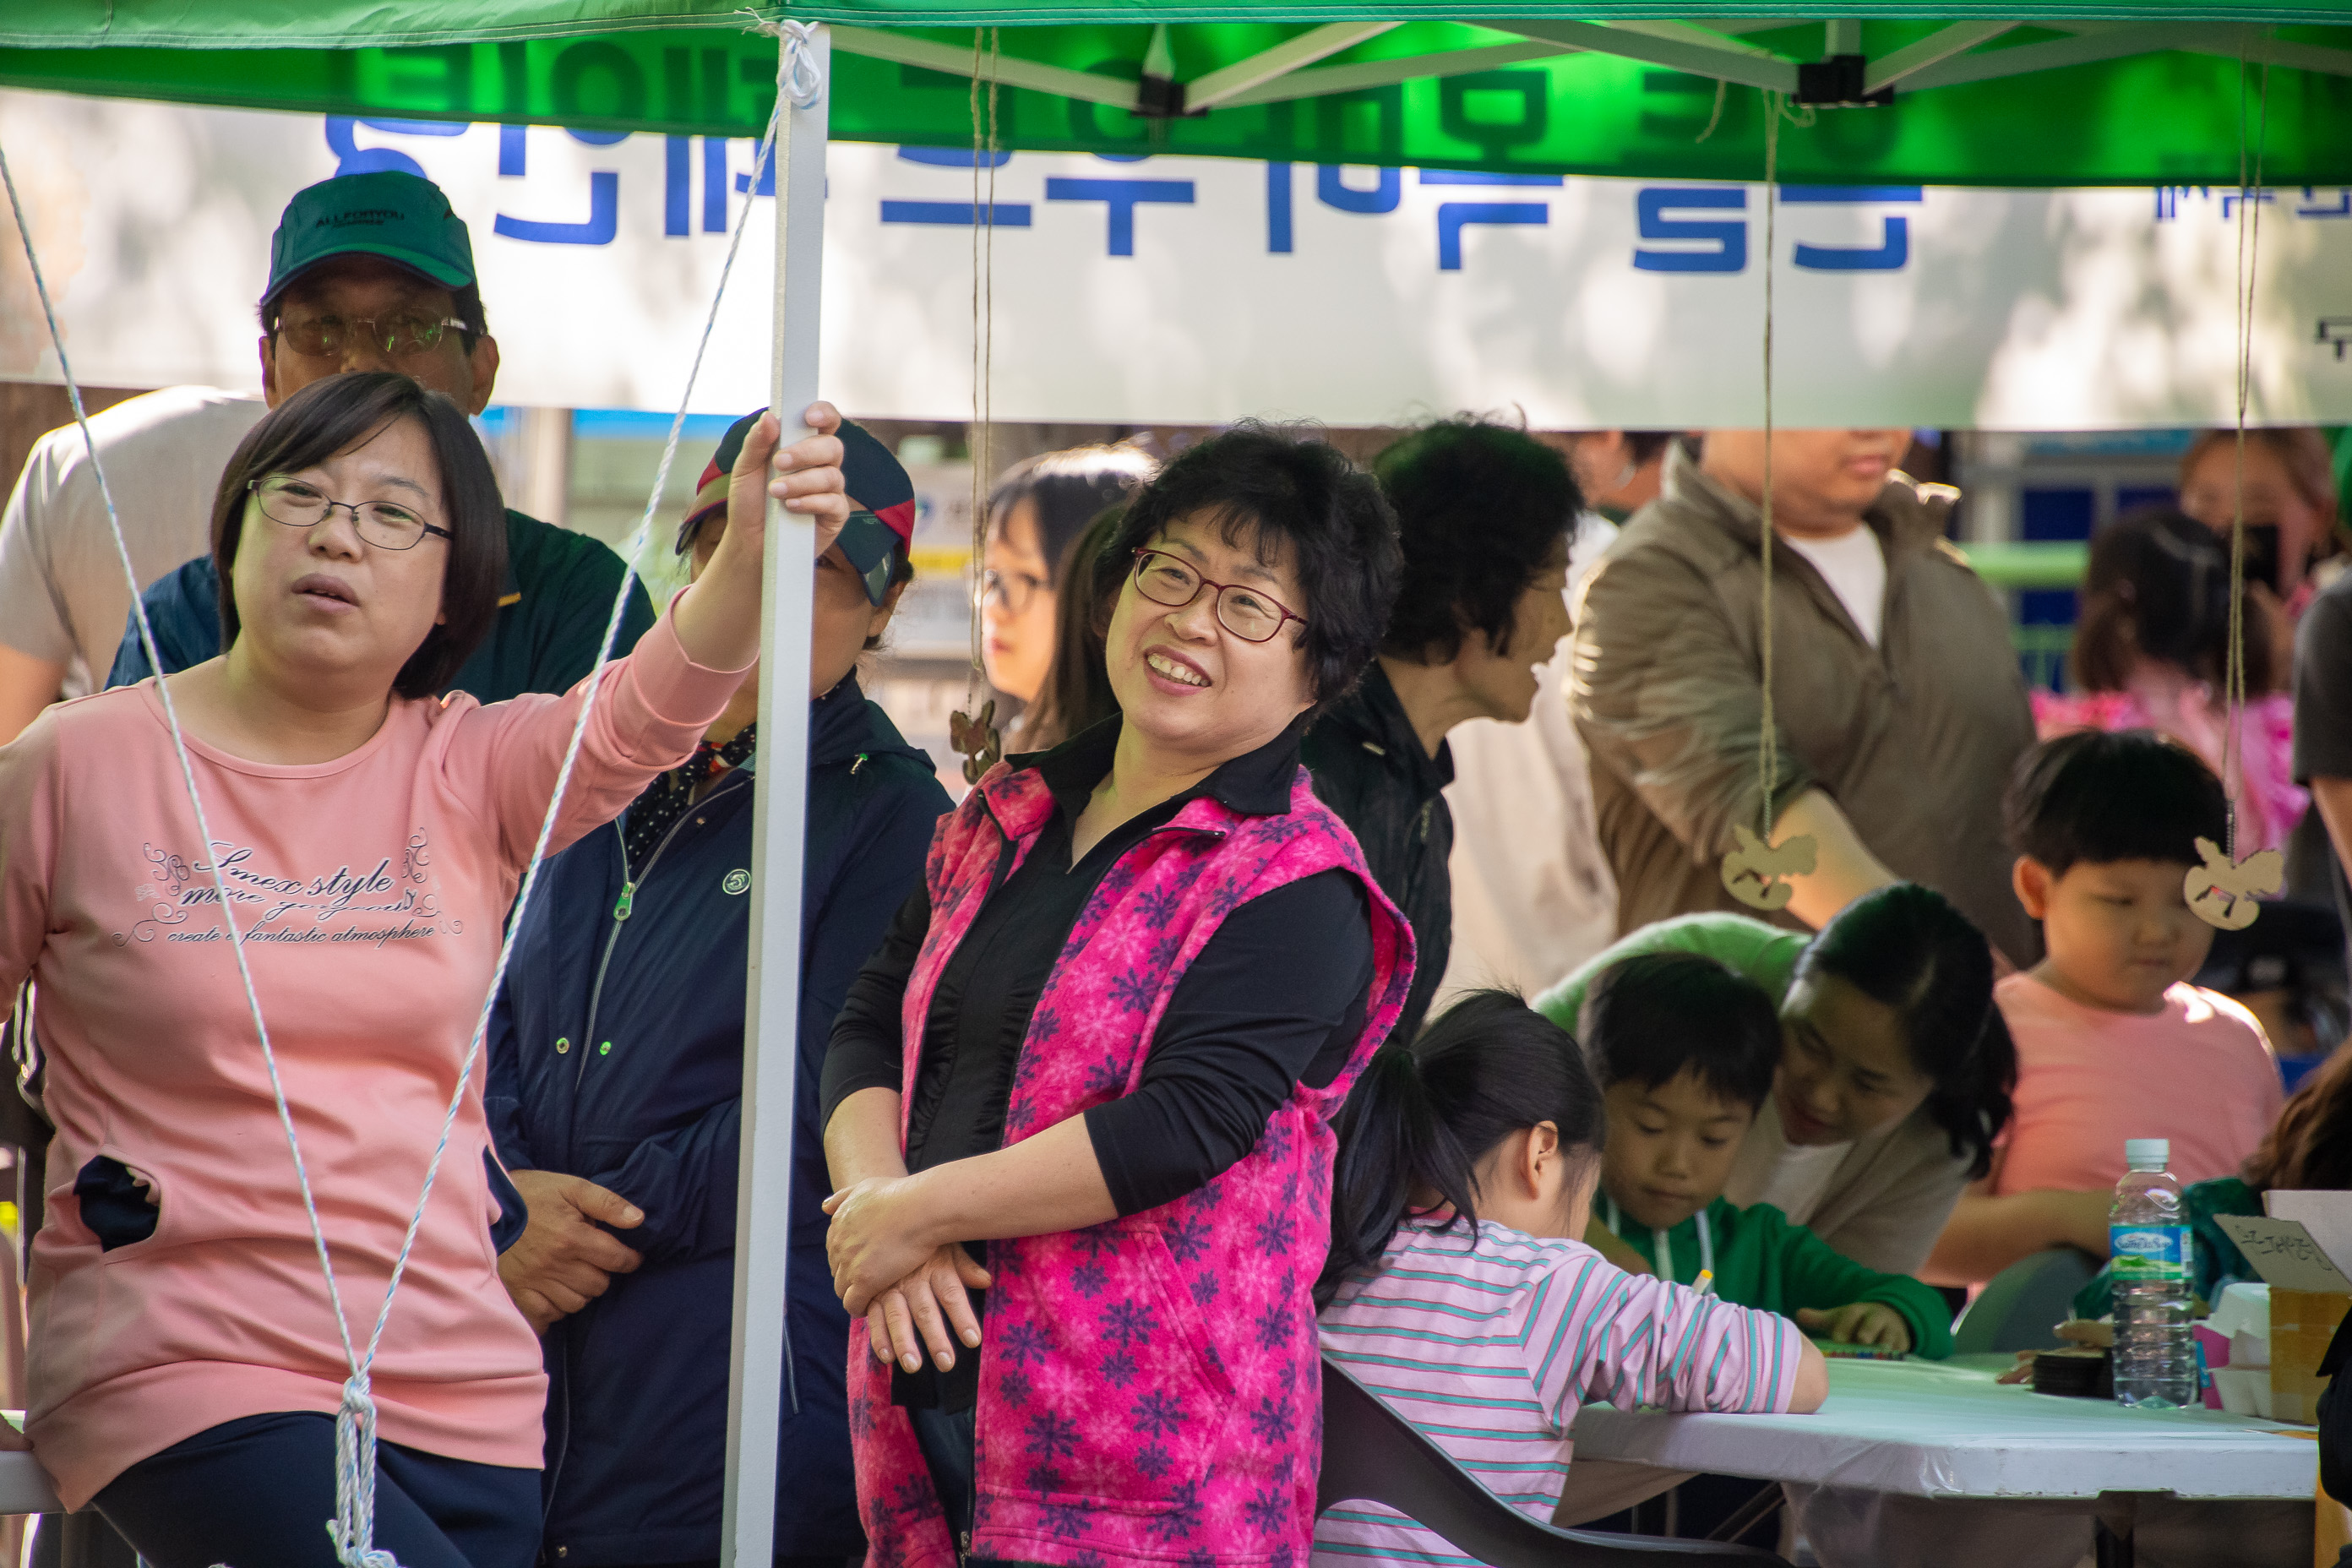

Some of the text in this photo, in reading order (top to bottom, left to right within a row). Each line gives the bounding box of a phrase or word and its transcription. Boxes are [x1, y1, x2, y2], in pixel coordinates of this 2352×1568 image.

[180, 886, 266, 906] more
[307, 858, 395, 907] style
[167, 926, 220, 942] create
[238, 920, 328, 946] fantastic
[330, 918, 435, 950] atmosphere
